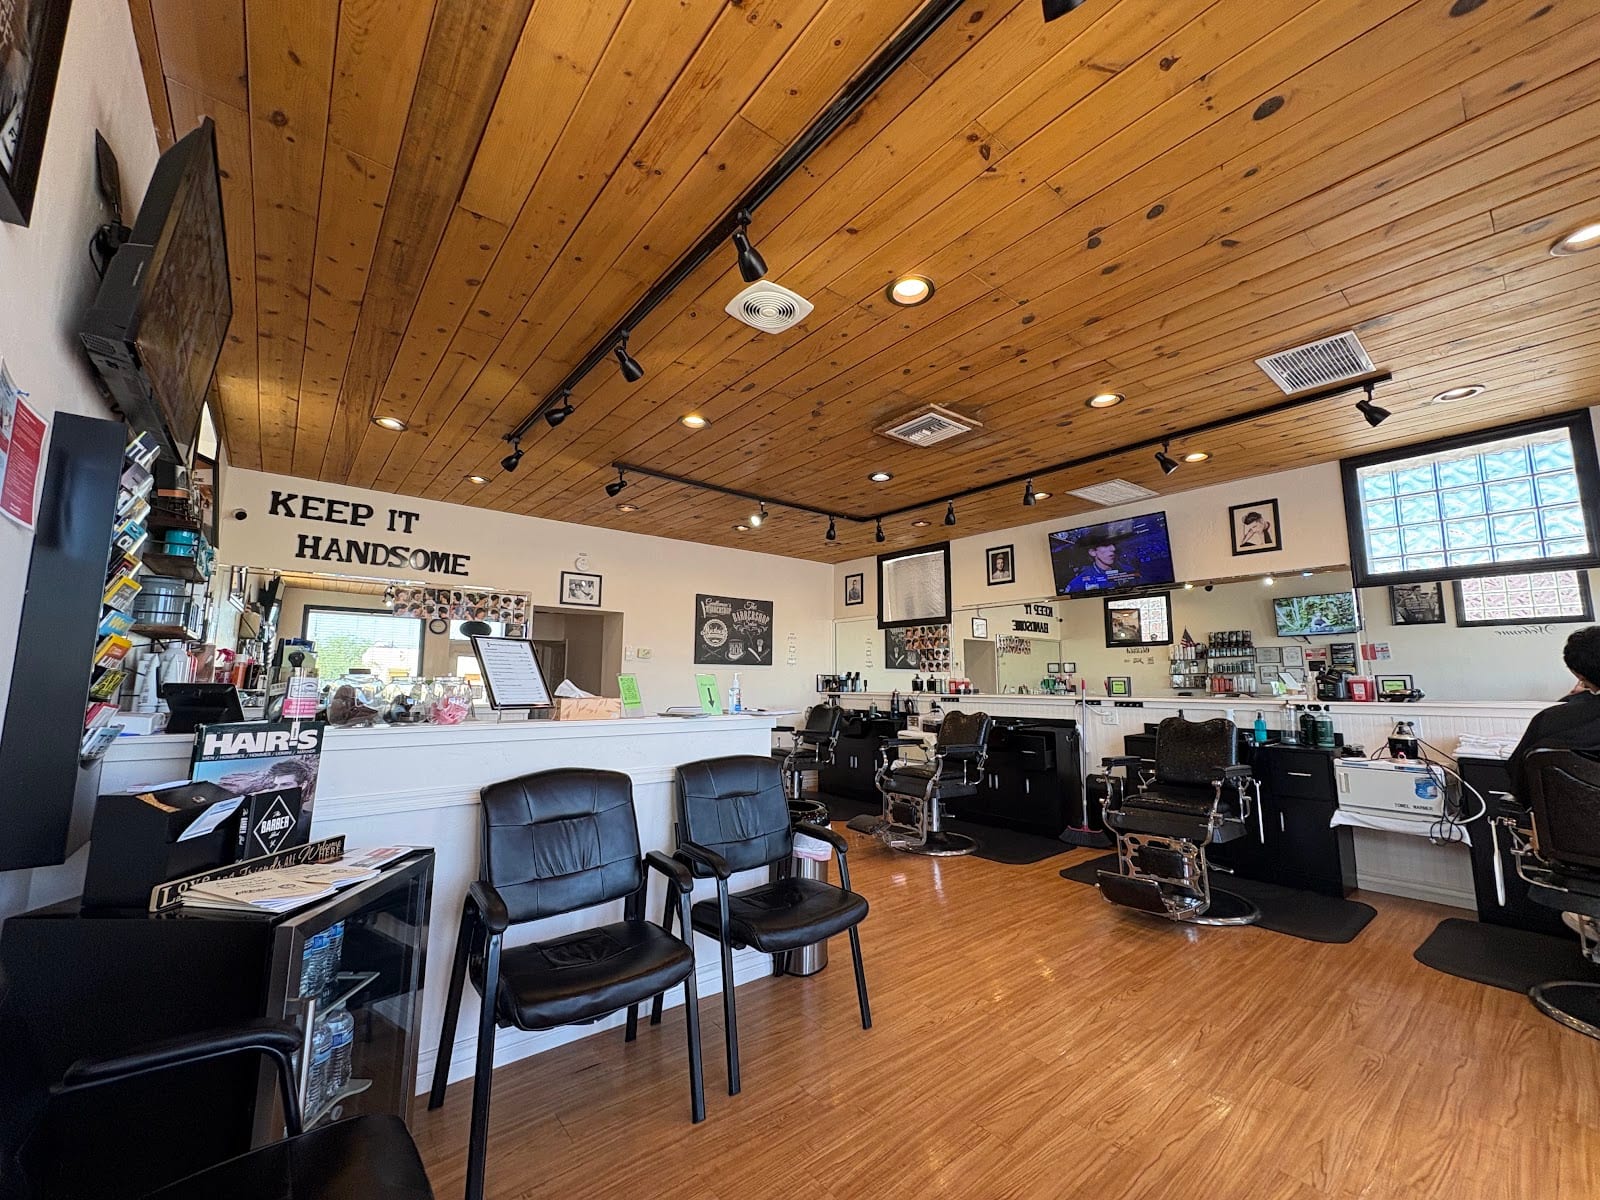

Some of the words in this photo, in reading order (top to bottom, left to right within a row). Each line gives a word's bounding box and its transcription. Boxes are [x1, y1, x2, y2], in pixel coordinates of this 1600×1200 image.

[268, 490, 374, 527] KEEP
[387, 509, 420, 534] IT
[295, 534, 471, 577] HANDSOME
[260, 815, 290, 834] BARBER
[318, 846, 342, 861] HERE
